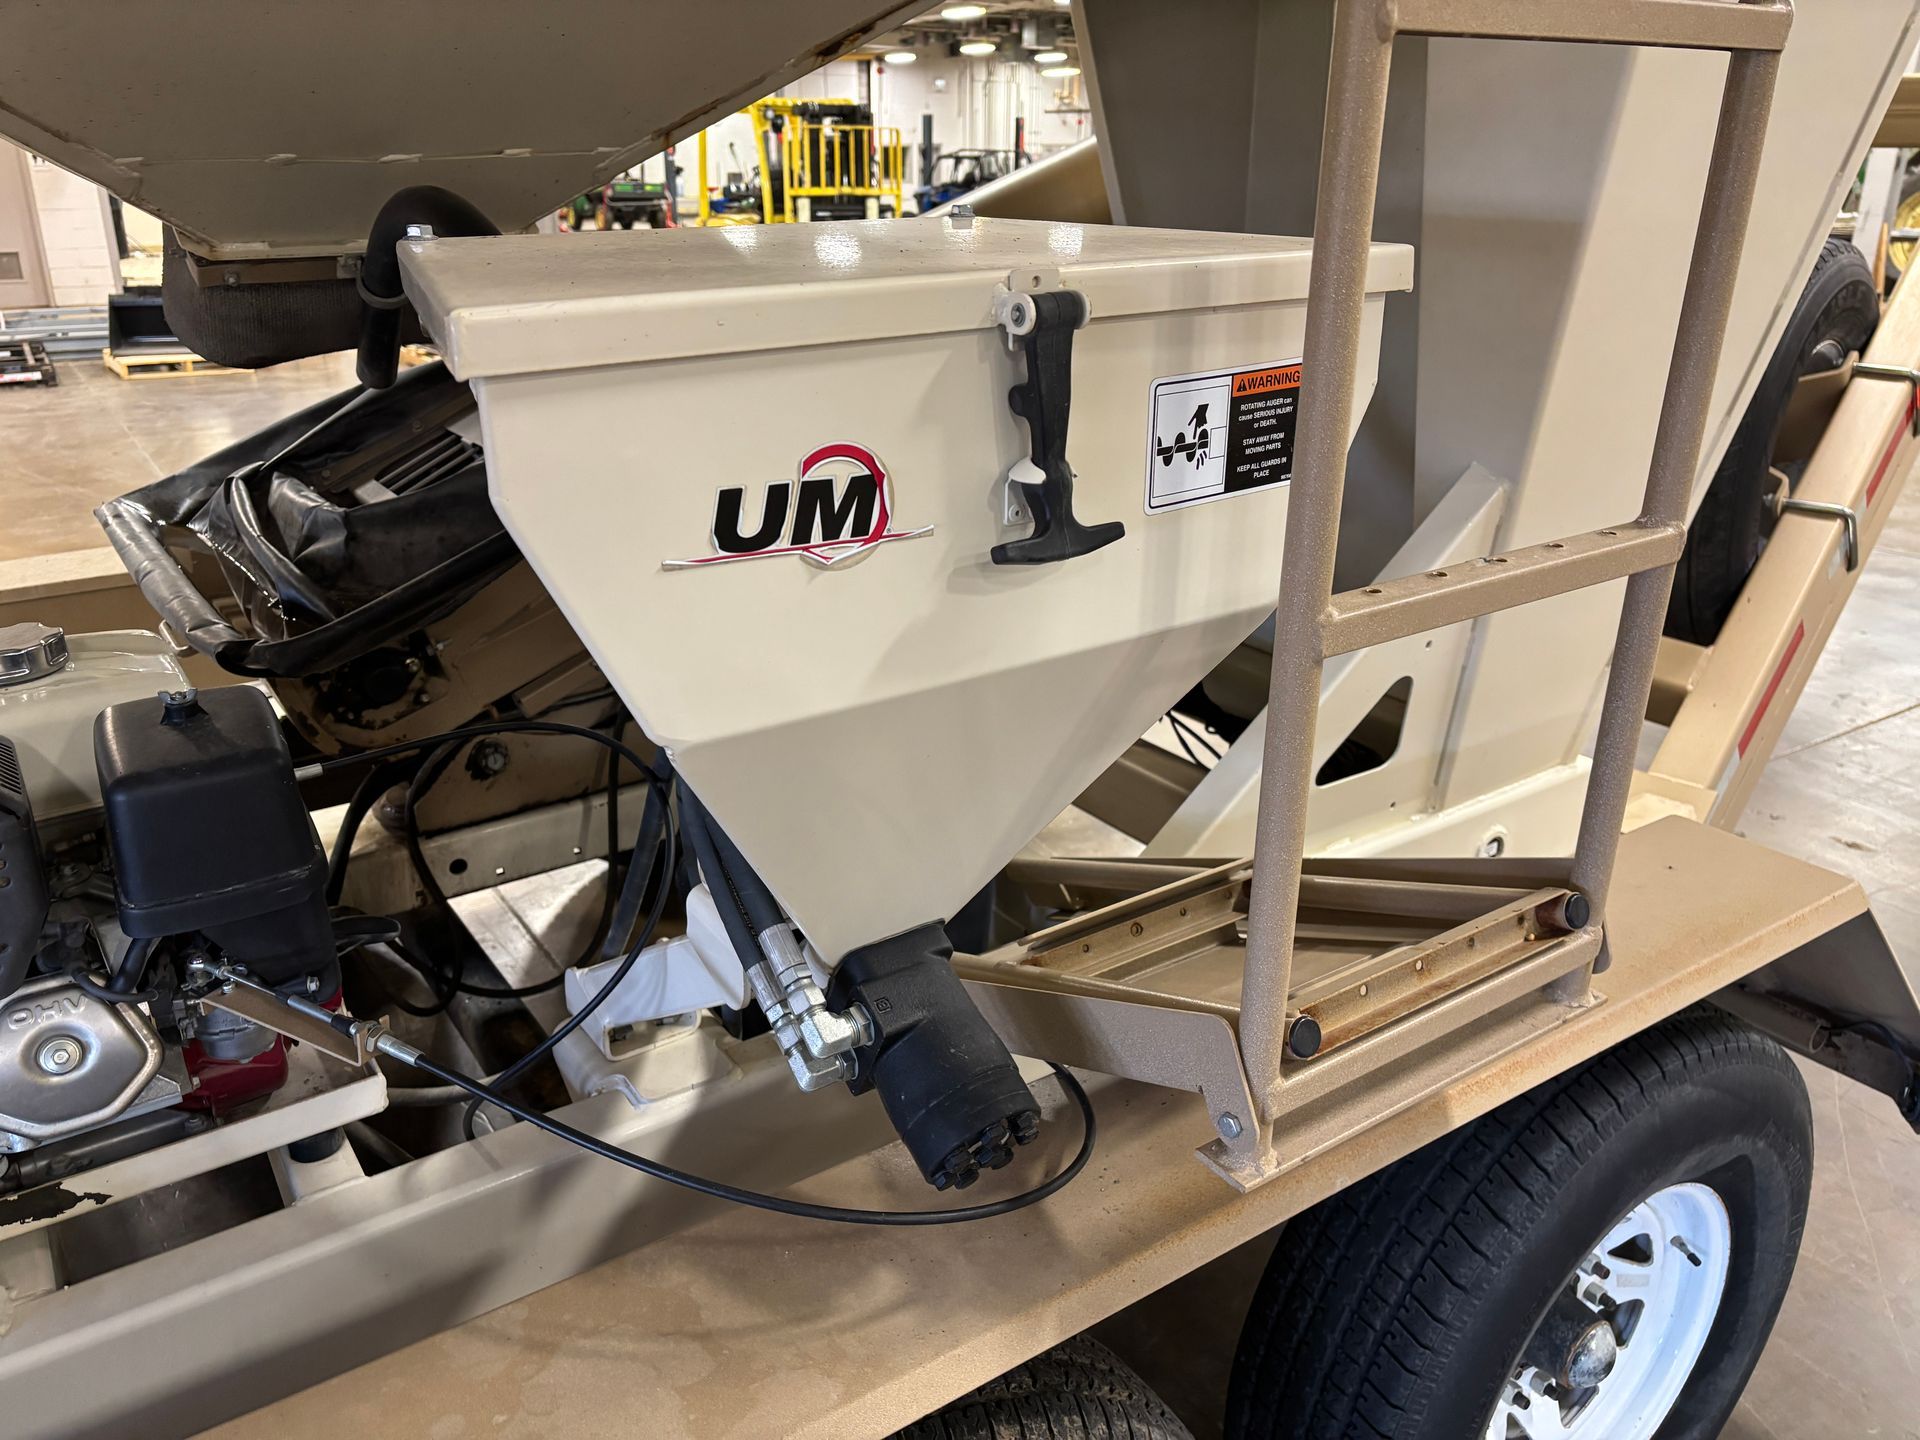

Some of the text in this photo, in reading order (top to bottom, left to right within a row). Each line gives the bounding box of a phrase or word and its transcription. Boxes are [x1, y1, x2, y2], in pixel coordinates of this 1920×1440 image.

[1248, 370, 1301, 390] WARNING
[1240, 400, 1266, 411] ROTATING
[1266, 397, 1284, 407] AUGER
[1238, 405, 1294, 422] cause SERIOUS INJURY
[1260, 418, 1277, 427] DEATH.
[1242, 431, 1285, 446] STAY AWAY FROM
[1245, 442, 1281, 455] MOVING PARTS
[1236, 464, 1251, 473] KEEP
[1250, 461, 1261, 470] ALL
[1260, 457, 1281, 468] GUARDS
[1253, 469, 1270, 478] PLACE
[713, 473, 879, 553] UM
[7, 993, 88, 1030] OHV
